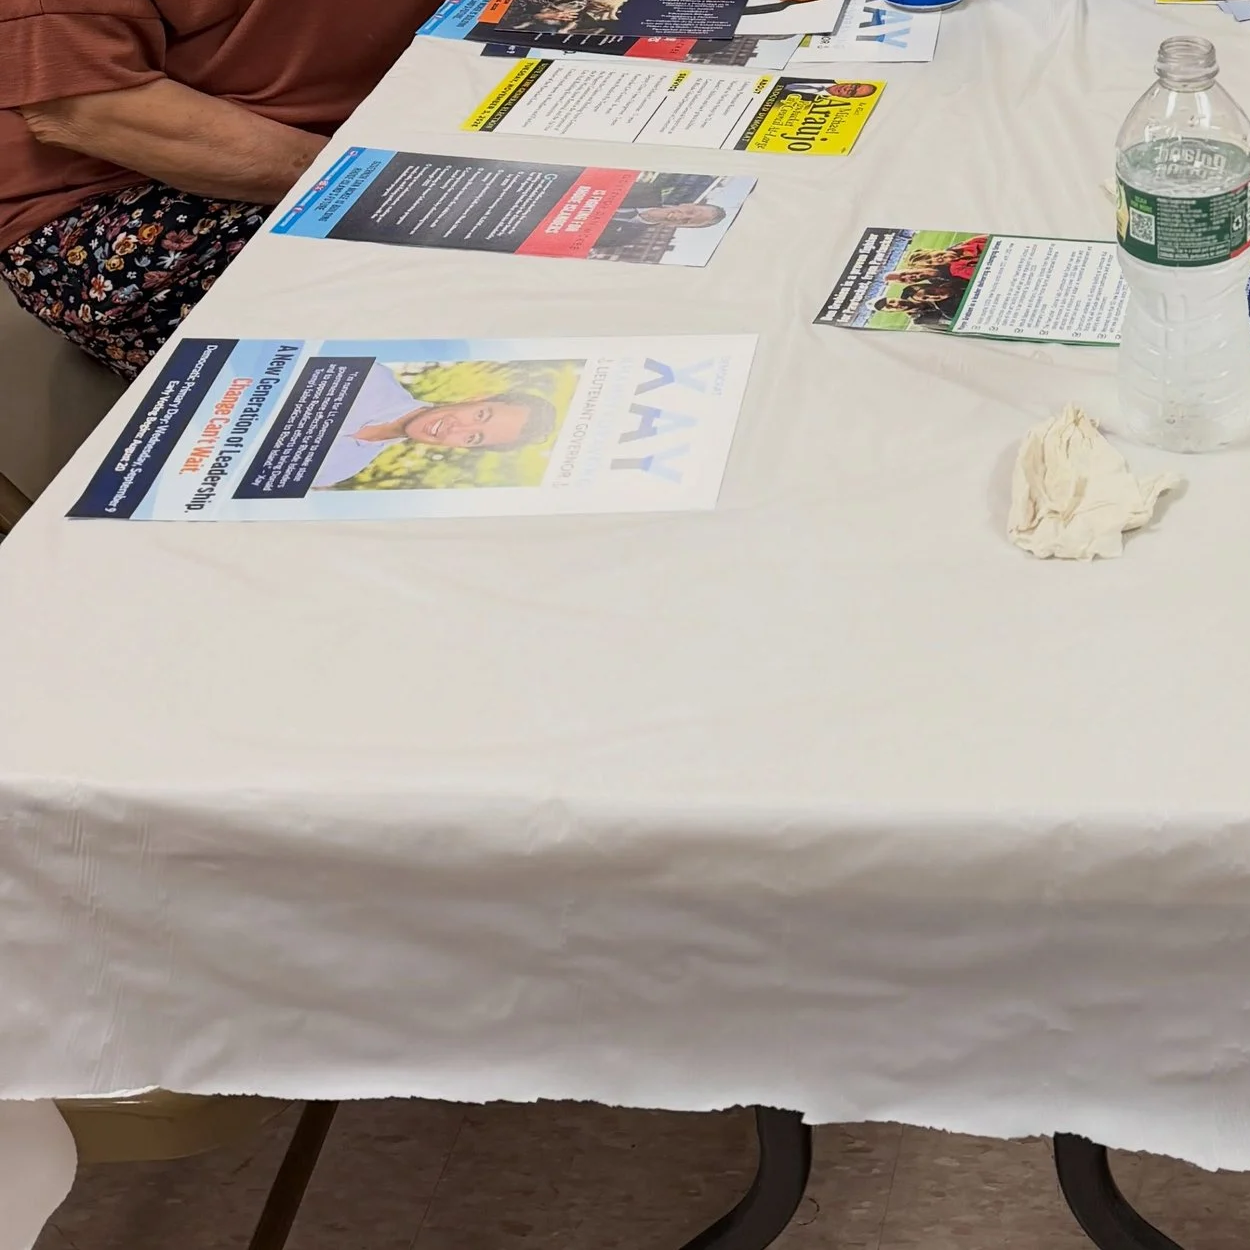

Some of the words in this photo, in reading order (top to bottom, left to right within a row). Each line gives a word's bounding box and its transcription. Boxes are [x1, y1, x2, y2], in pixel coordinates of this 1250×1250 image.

[664, 73, 690, 92] SERVICE
[750, 78, 769, 94] ABOUT
[737, 112, 767, 141] DEMOCRAT
[770, 96, 853, 153] Araujo
[823, 108, 851, 134] Michael
[542, 203, 579, 234] ISLANDERS
[571, 195, 603, 220] FIGHTING
[857, 233, 882, 253] fighter
[867, 232, 897, 264] Pawtucket.
[849, 253, 871, 274] proven
[860, 265, 878, 279] from
[826, 287, 851, 309] Grebien
[841, 280, 872, 313] Pawtucket,
[820, 310, 837, 320] Don
[836, 313, 852, 322] for
[184, 345, 220, 380] Democratic
[261, 354, 295, 375] New
[159, 380, 181, 394] Early
[167, 381, 197, 407] Primary
[210, 378, 255, 414] Change
[575, 366, 609, 420] LIEUTENANT
[146, 396, 171, 415] Voting
[156, 408, 180, 424] Day:
[227, 377, 282, 433] Generation
[193, 417, 231, 443] Can't
[603, 357, 715, 485] XAY
[116, 439, 143, 461] August
[129, 425, 169, 466] Wednesday,
[219, 436, 248, 447] of
[555, 422, 590, 477] GOVERNOR
[110, 462, 129, 471] 20
[174, 446, 215, 474] Wait.
[103, 468, 143, 507] September
[181, 449, 241, 512] Leadership.
